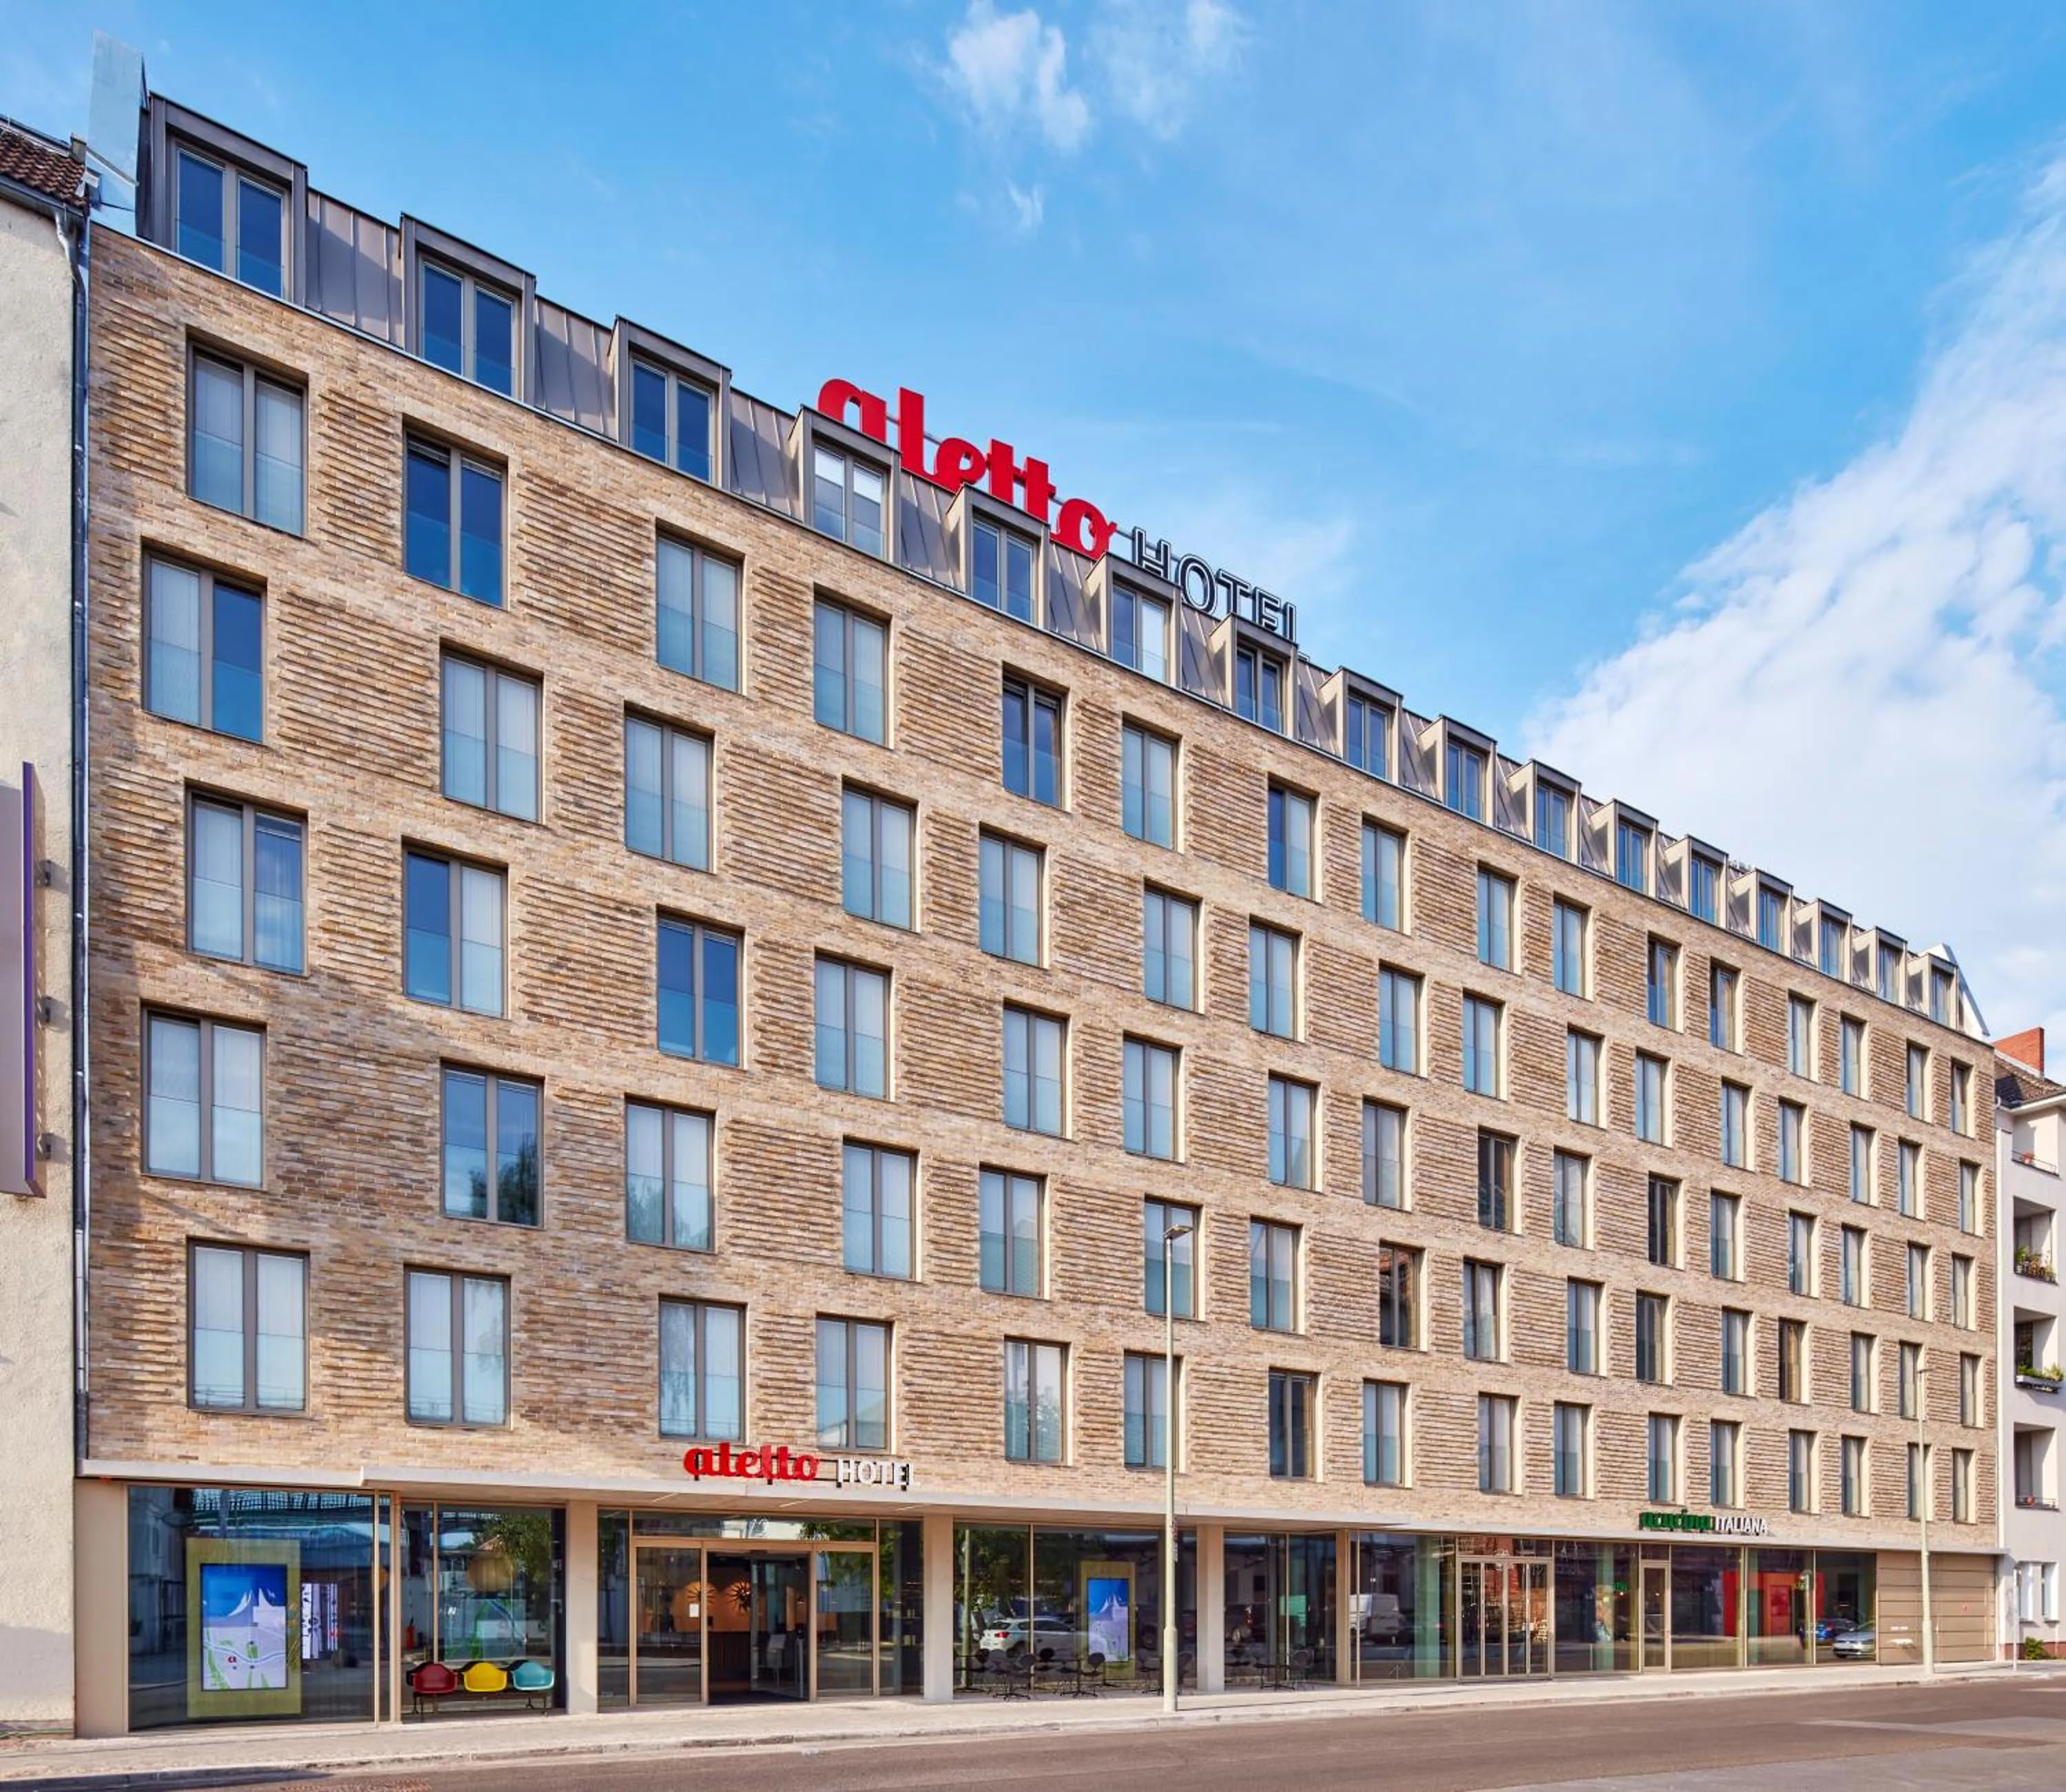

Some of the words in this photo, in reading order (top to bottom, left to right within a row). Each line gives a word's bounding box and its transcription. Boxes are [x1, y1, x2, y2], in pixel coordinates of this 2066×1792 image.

[684, 1442, 820, 1482] aletto
[837, 1457, 920, 1487] HOTEL
[1715, 1516, 1768, 1534] ITALIANA
